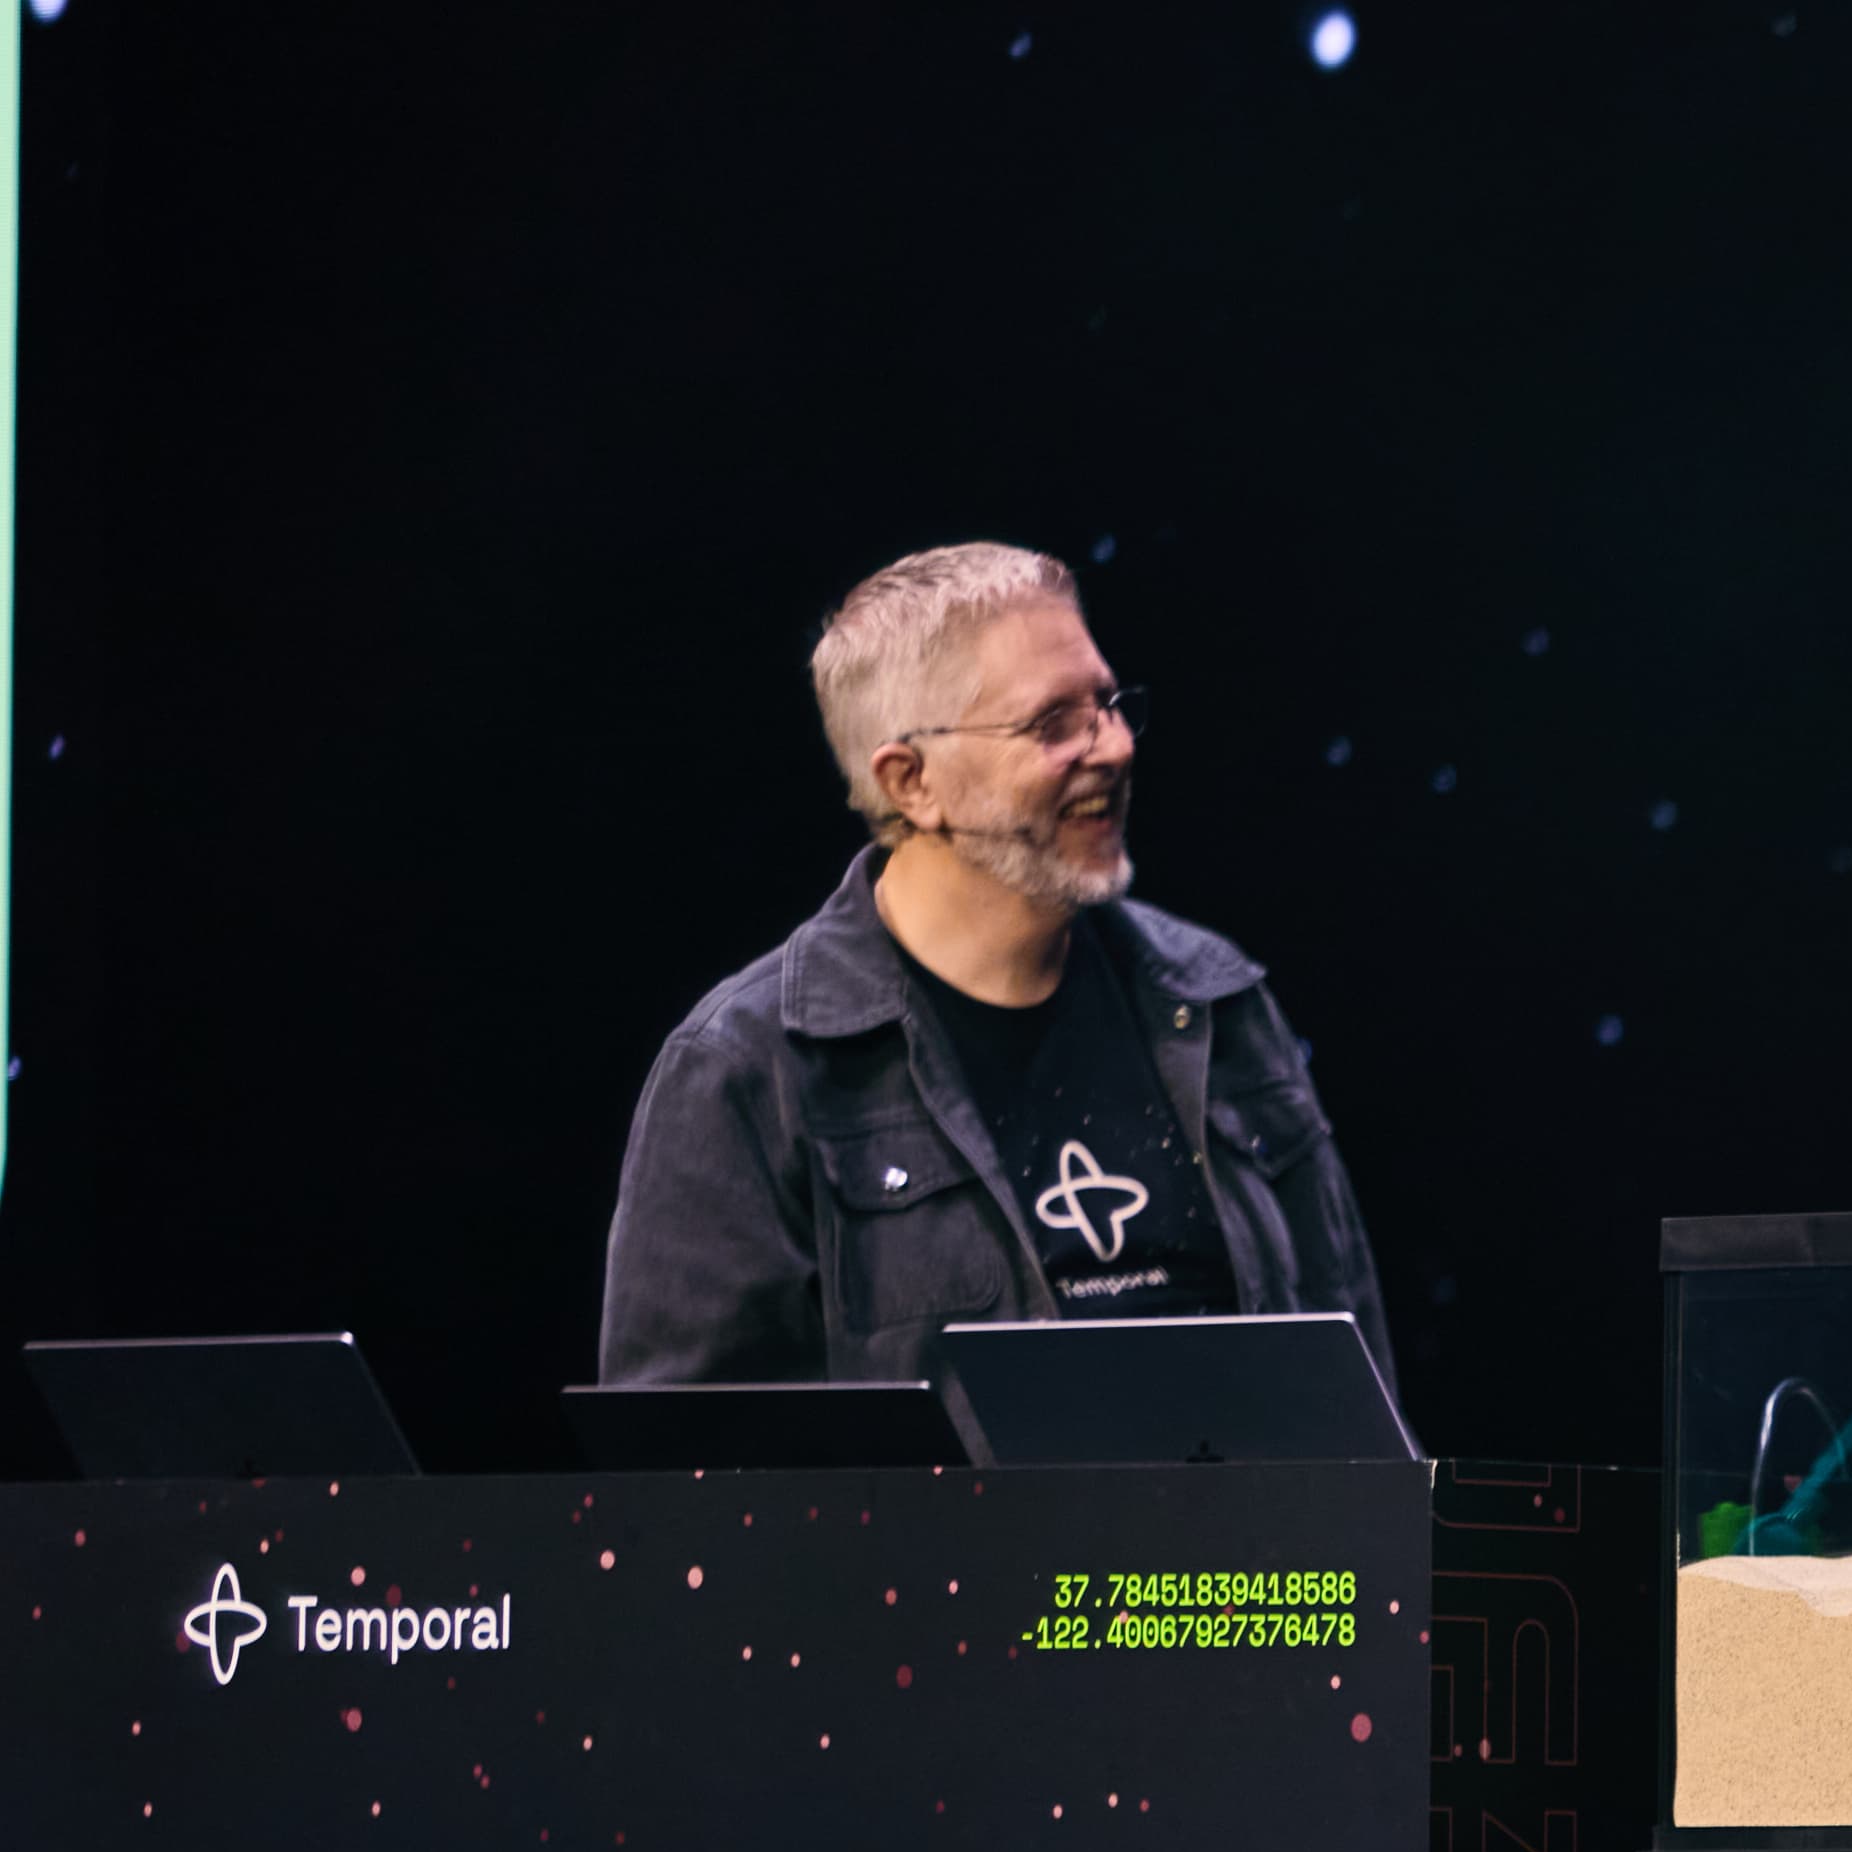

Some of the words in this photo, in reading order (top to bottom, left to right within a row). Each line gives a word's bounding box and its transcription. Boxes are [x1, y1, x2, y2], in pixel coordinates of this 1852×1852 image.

[1058, 1267, 1168, 1299] Temporal
[1054, 1571, 1357, 1608] 37.78451839418586
[287, 1593, 511, 1665] Temporal
[1021, 1613, 1357, 1650] -122.40067927376478
